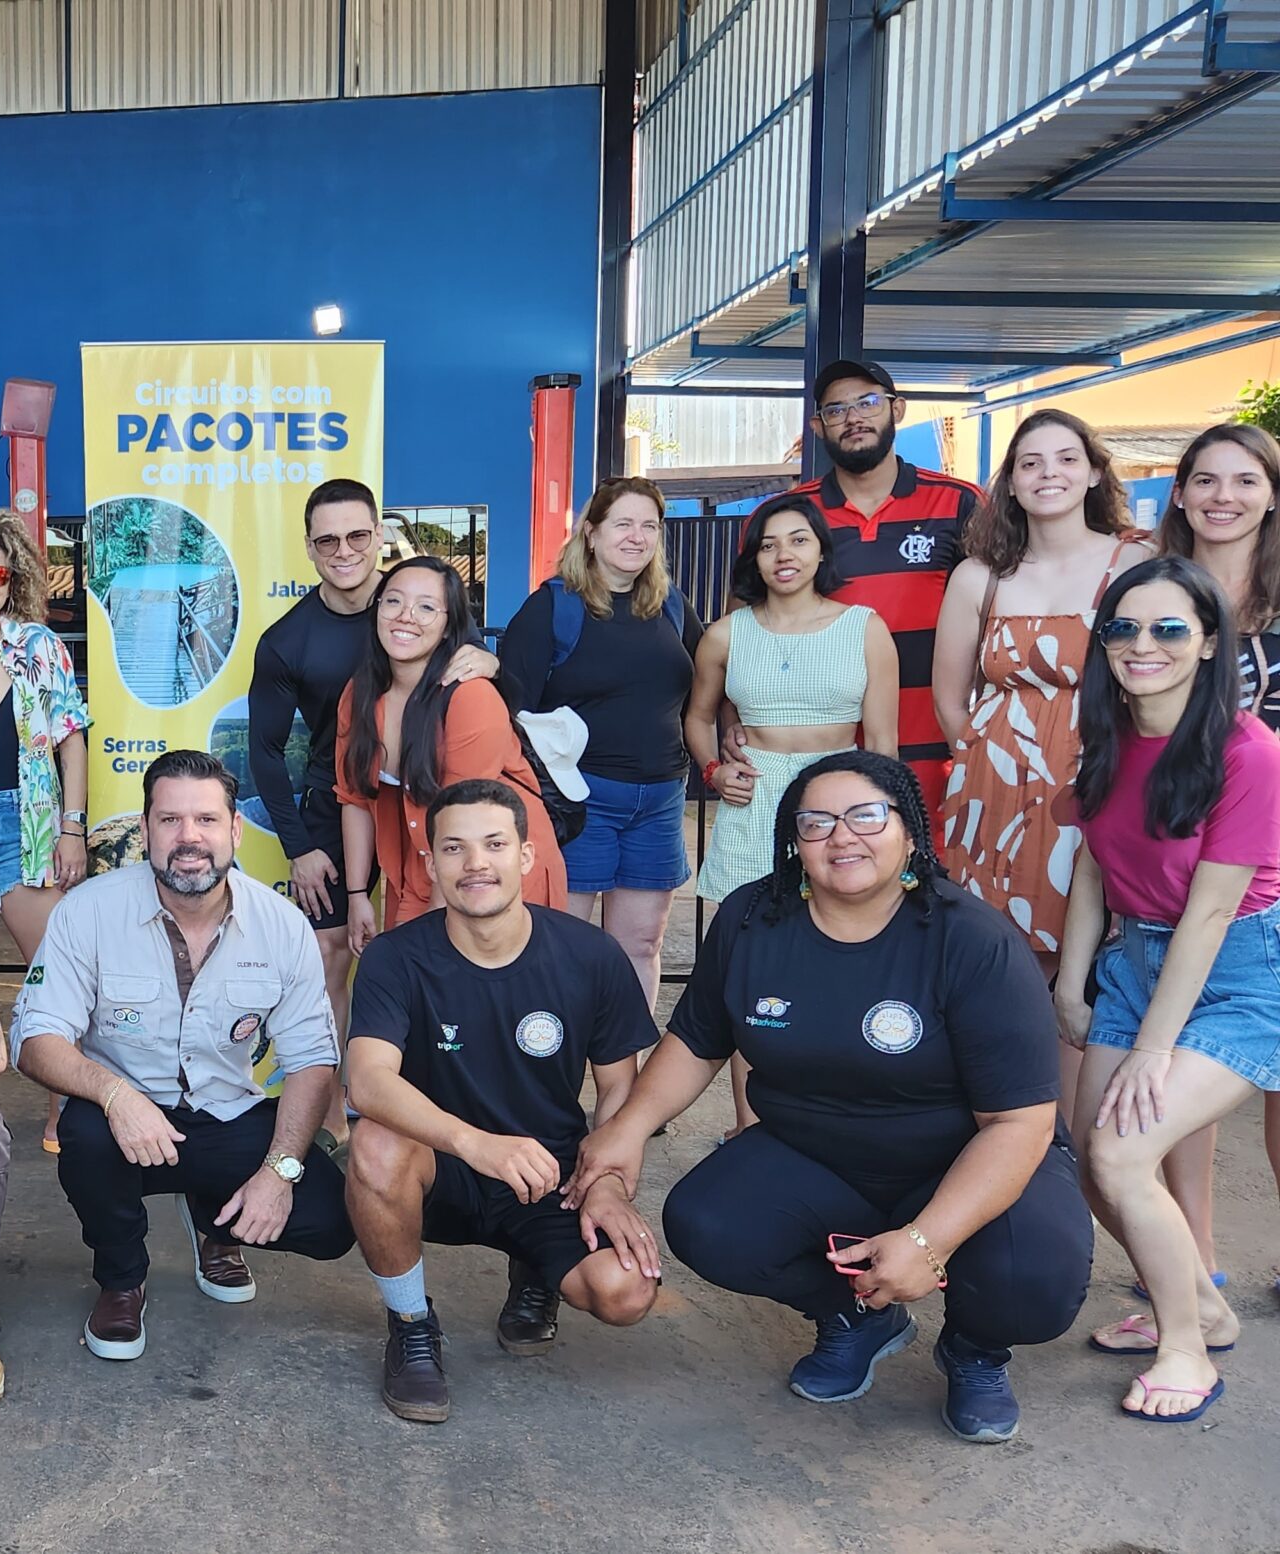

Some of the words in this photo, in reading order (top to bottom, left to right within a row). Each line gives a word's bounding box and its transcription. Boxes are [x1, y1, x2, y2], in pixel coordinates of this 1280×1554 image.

[135, 378, 261, 407] Circuitos
[271, 382, 332, 405] com
[116, 411, 349, 453] PACOTES
[141, 456, 323, 489] completos
[103, 737, 167, 753] Serras
[112, 757, 152, 773] Ger
[745, 1014, 791, 1030] tripadvisor
